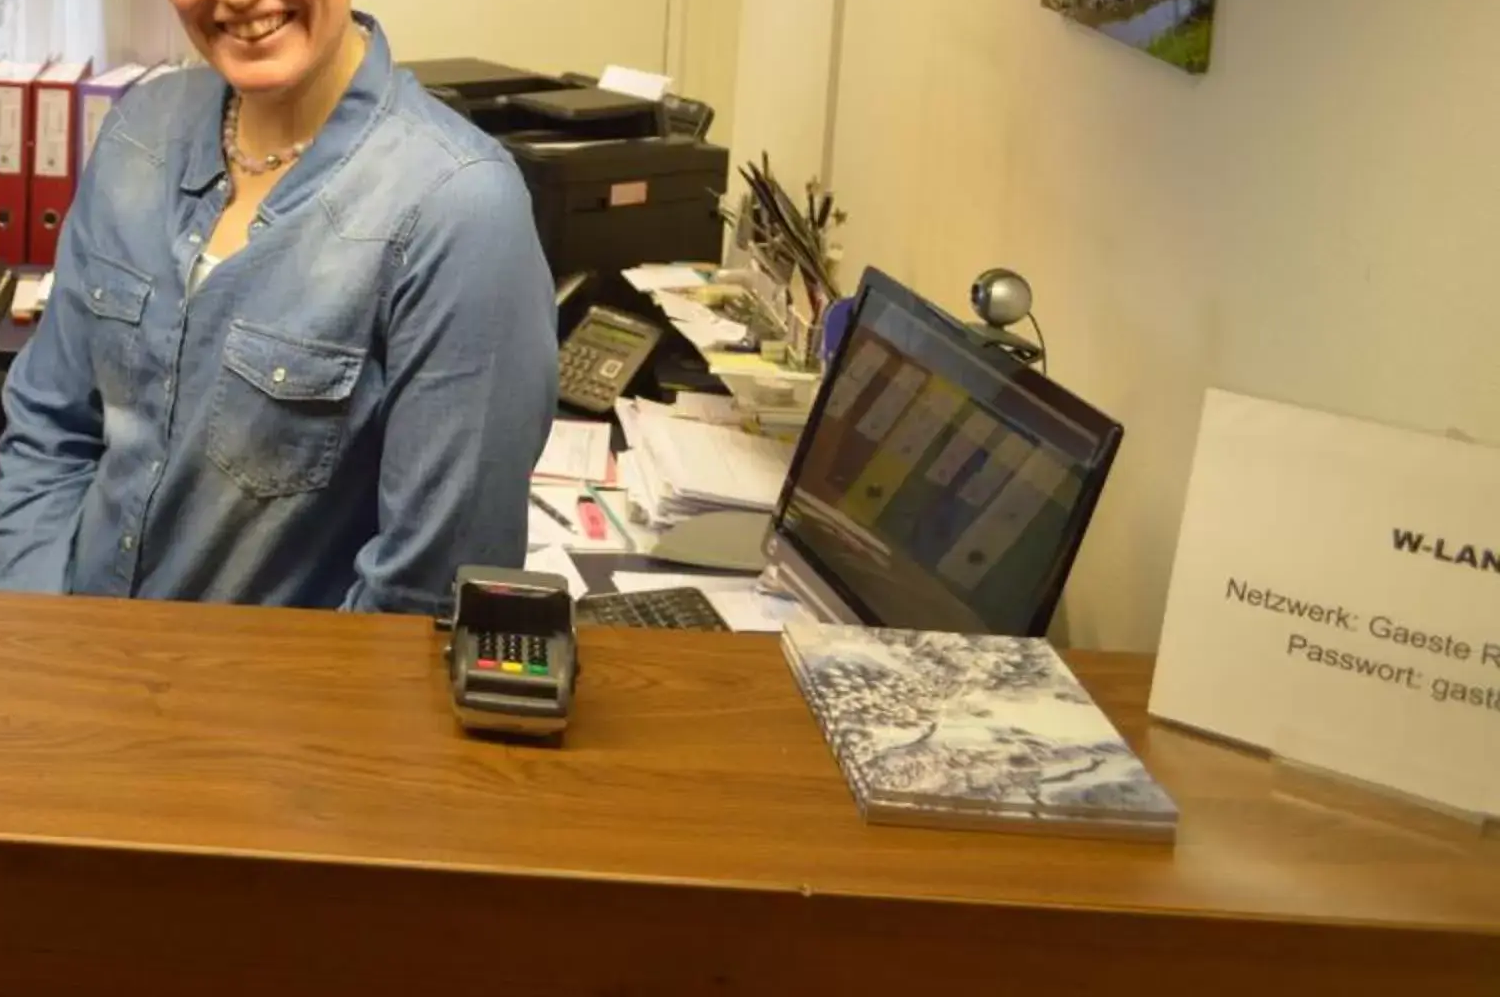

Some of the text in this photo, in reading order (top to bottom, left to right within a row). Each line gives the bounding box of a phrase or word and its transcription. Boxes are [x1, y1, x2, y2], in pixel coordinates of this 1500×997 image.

[1225, 577, 1360, 632] Netzwerk:
[1368, 615, 1472, 661] Gaeste
[1286, 633, 1424, 690] Passwort:
